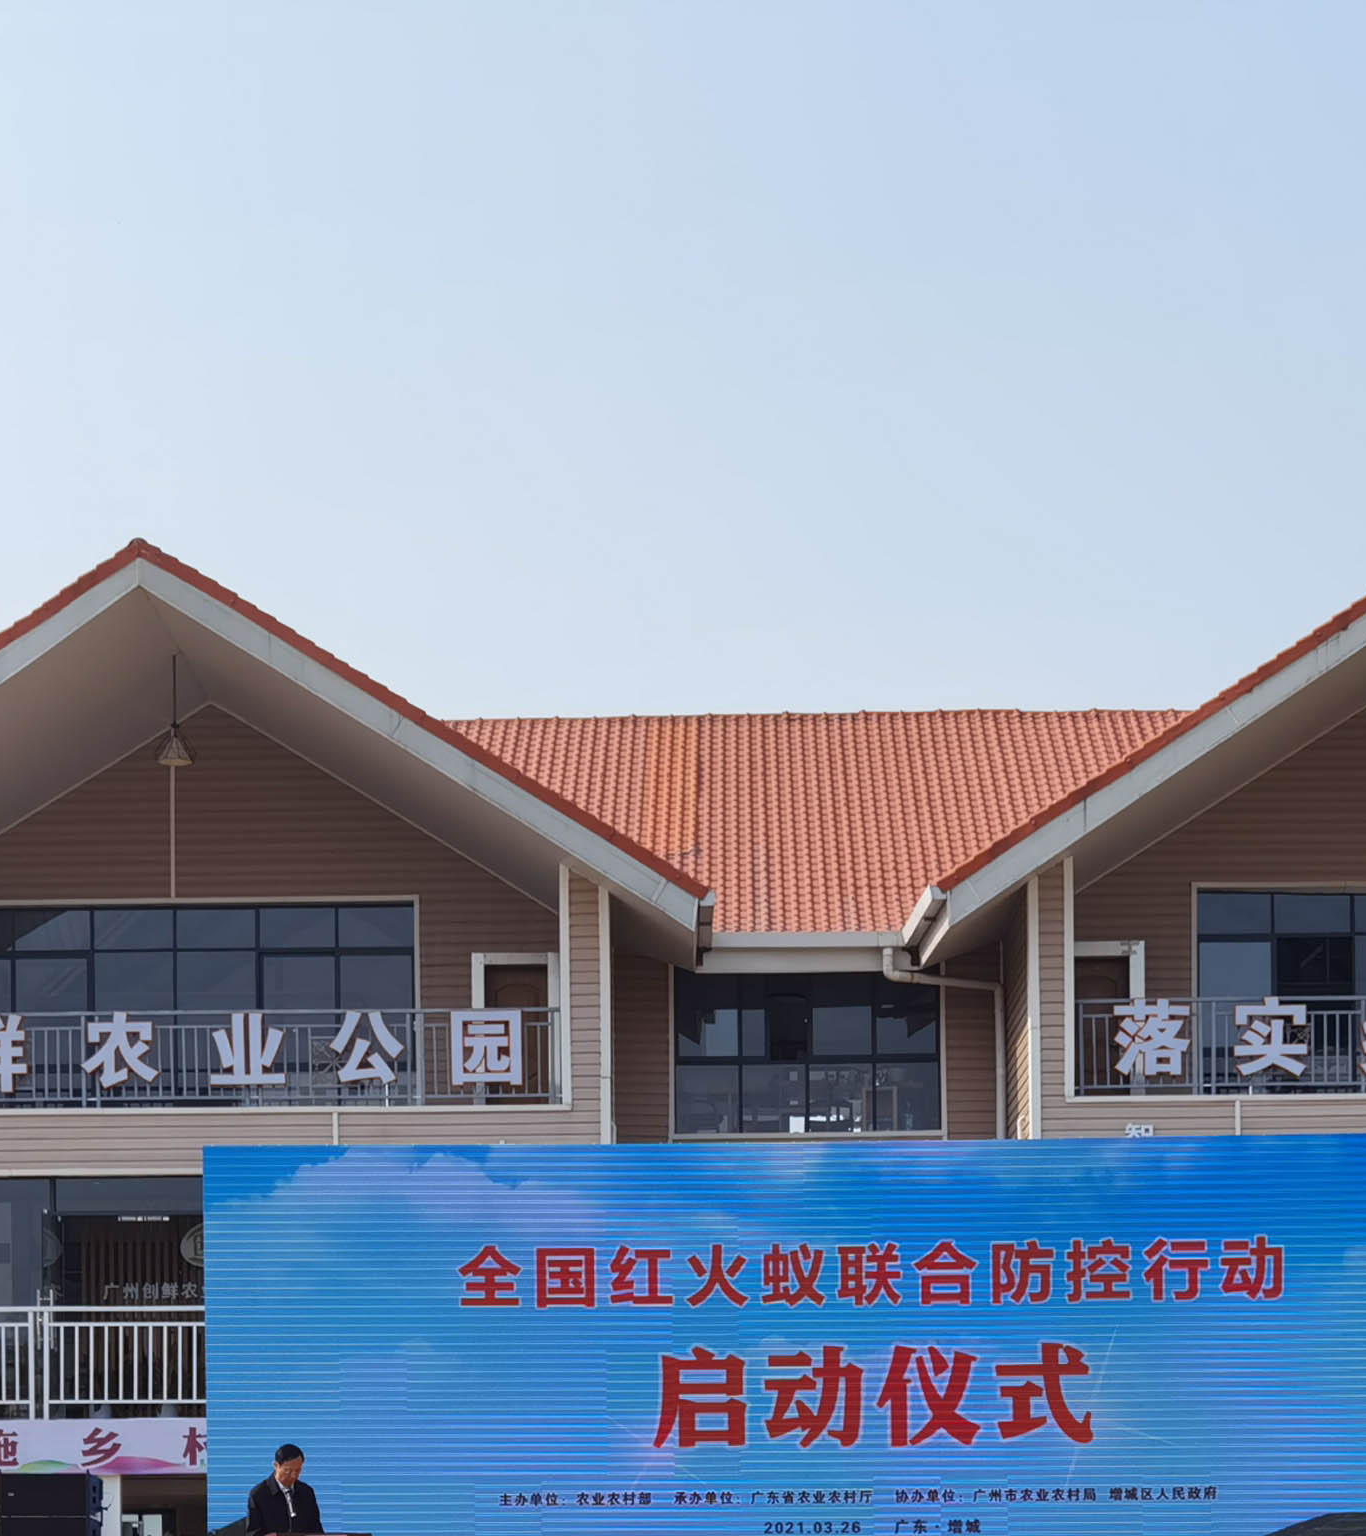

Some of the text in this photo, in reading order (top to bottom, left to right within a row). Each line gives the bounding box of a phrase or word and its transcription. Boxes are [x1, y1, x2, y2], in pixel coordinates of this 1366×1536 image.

[455, 1234, 1286, 1309] 全国红火蚁联合防控行动
[103, 1281, 205, 1300] 广州创鲜农
[651, 1341, 1096, 1450] 启动仪式
[1108, 1485, 1219, 1502] 增城区人民政府
[763, 1520, 863, 1535] 2021.03.26
